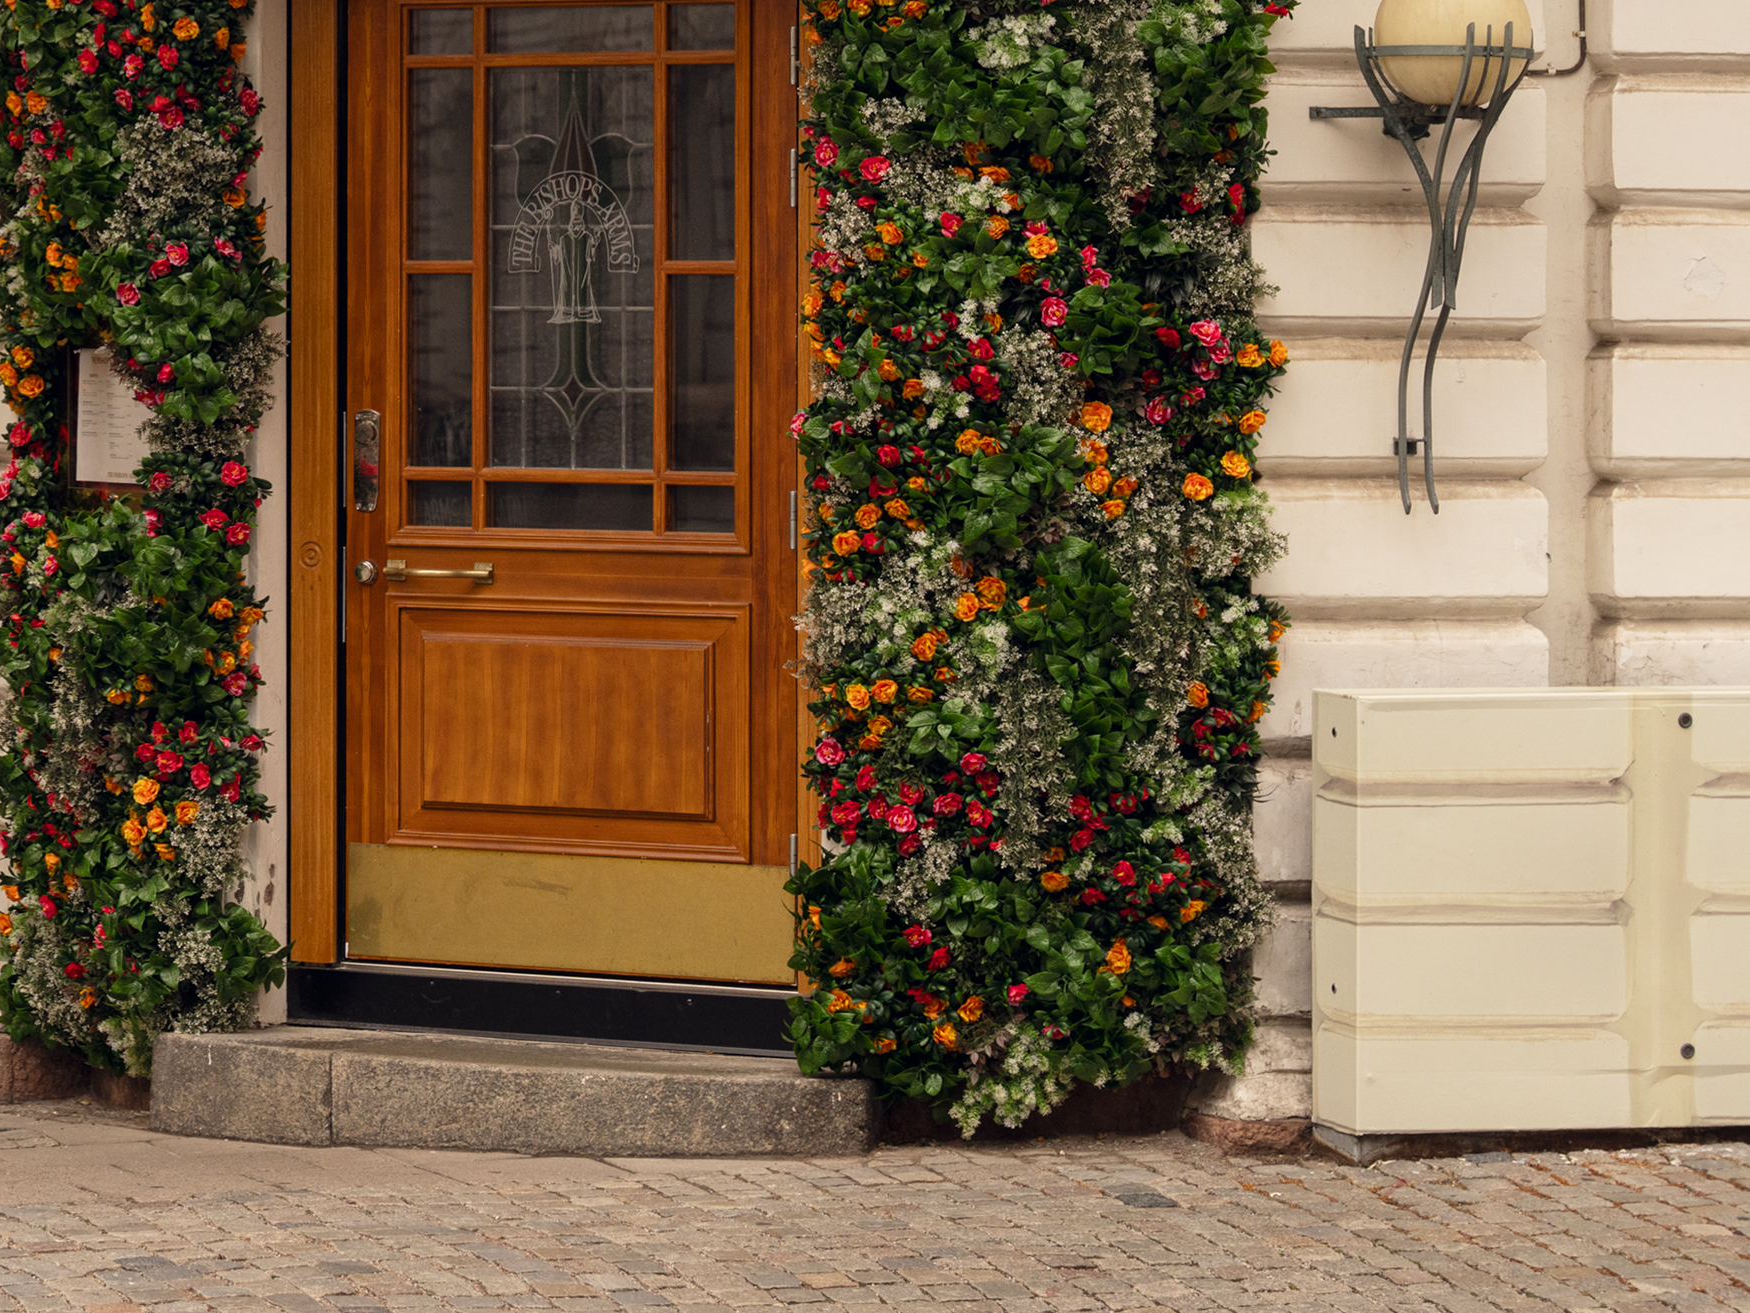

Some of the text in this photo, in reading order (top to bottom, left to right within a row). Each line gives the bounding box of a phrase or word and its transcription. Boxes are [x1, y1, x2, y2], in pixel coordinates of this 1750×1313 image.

[512, 174, 632, 266] THE BISHOPS ARMS
